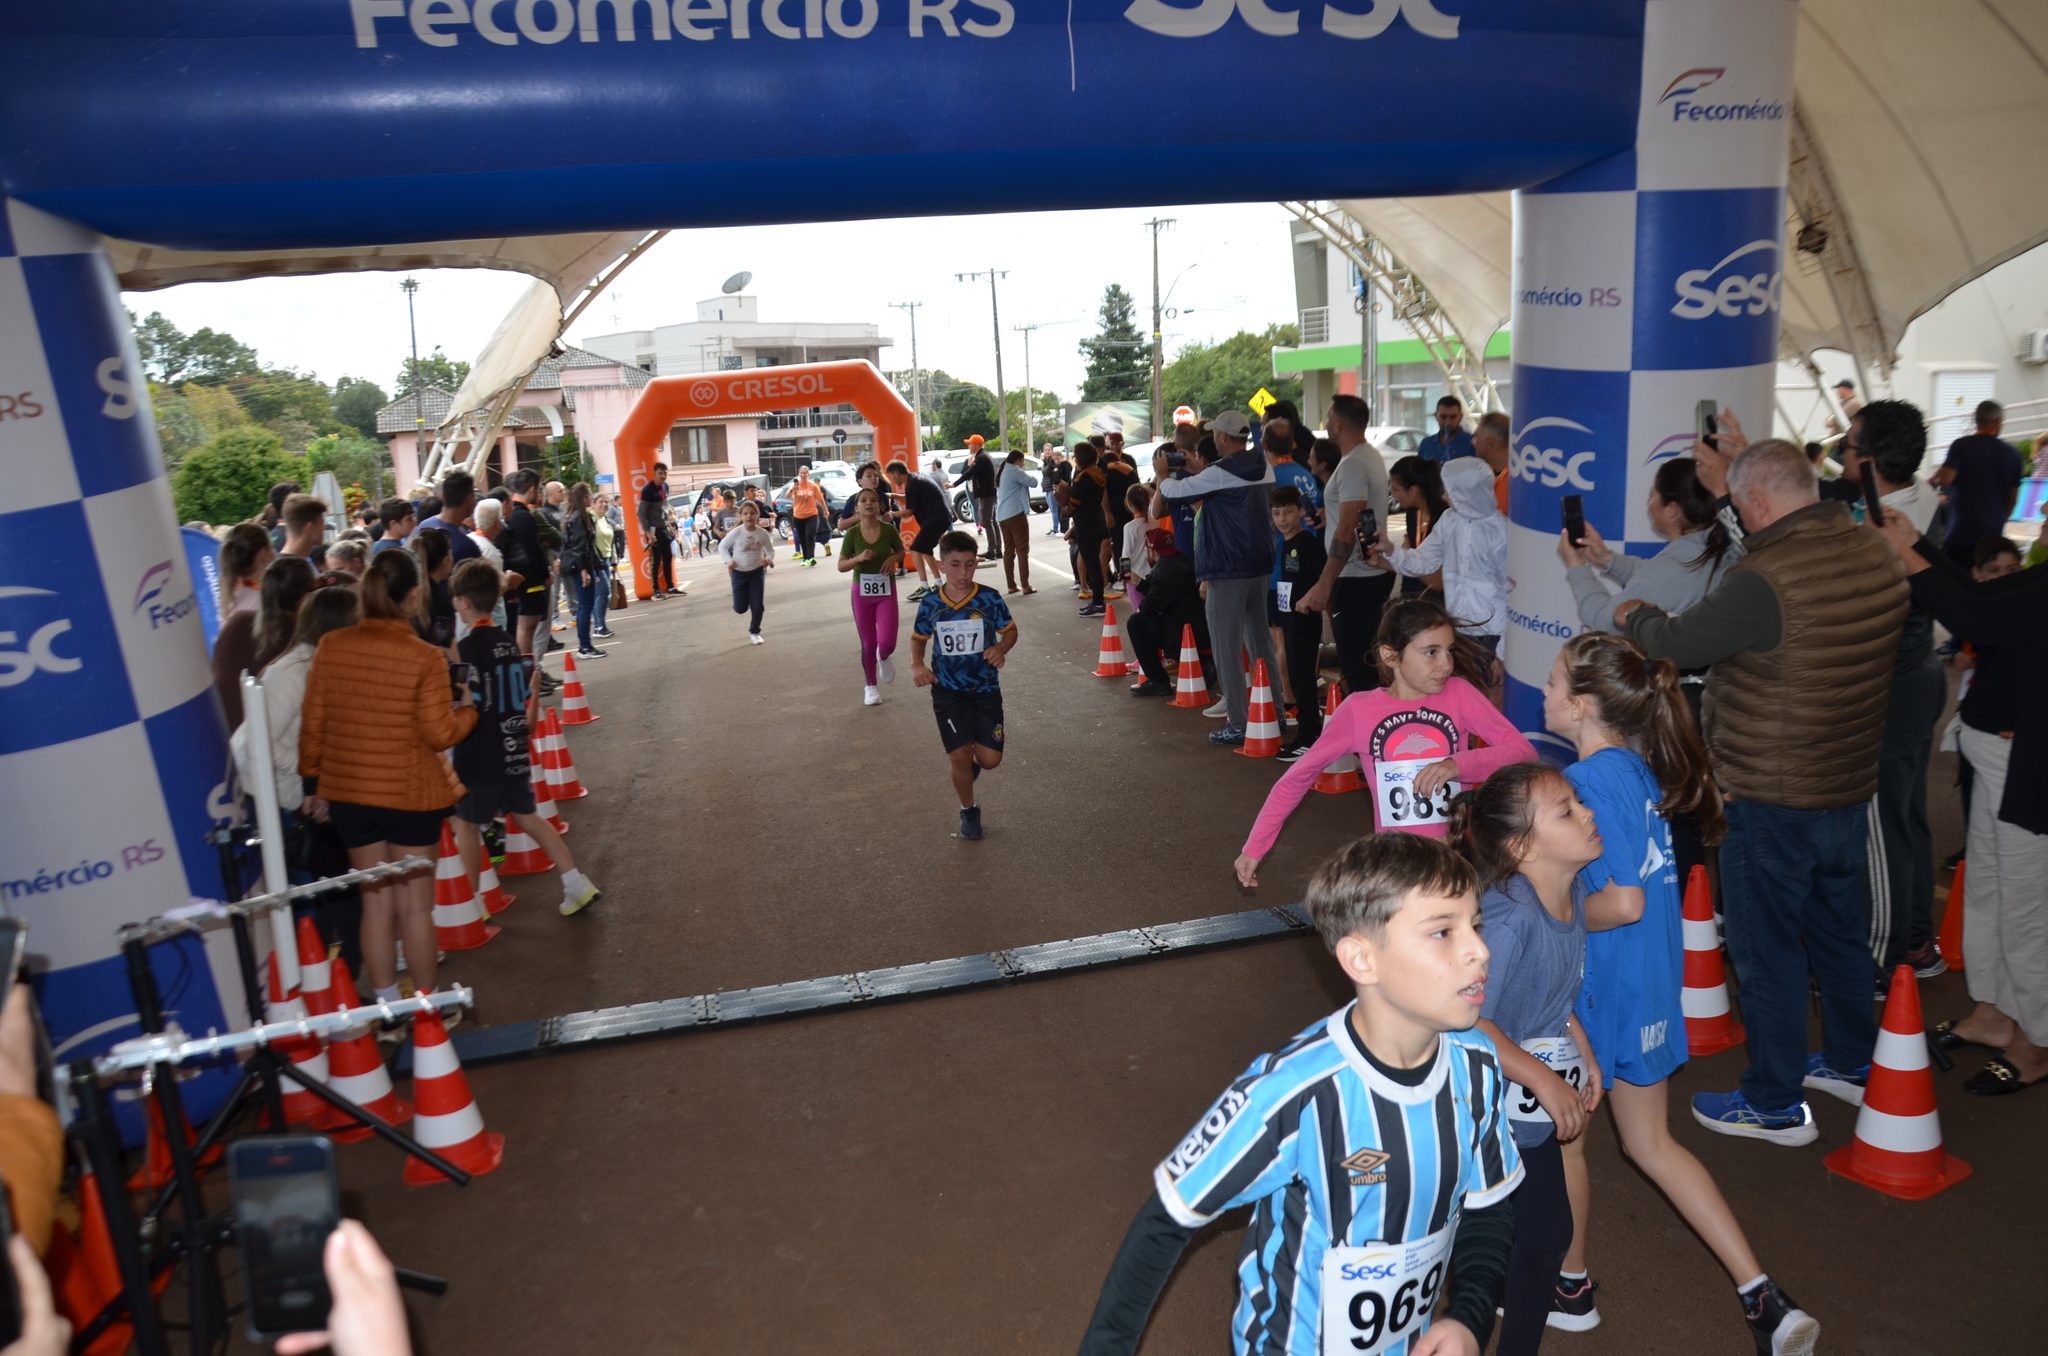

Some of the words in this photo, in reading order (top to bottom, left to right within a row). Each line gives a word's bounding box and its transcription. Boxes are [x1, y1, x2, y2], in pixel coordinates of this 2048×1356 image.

[908, 0, 1016, 38] RS
[1589, 287, 1622, 308] RS
[727, 373, 834, 401] CRESOL
[863, 581, 887, 595] 981
[943, 632, 979, 653] 987
[1416, 709, 1444, 723] SOME
[1389, 786, 1452, 822] 983
[121, 837, 166, 872] RS
[1350, 1171, 1387, 1186] umbro
[1340, 1262, 1397, 1281] Sesc
[1348, 1260, 1443, 1350] 969
